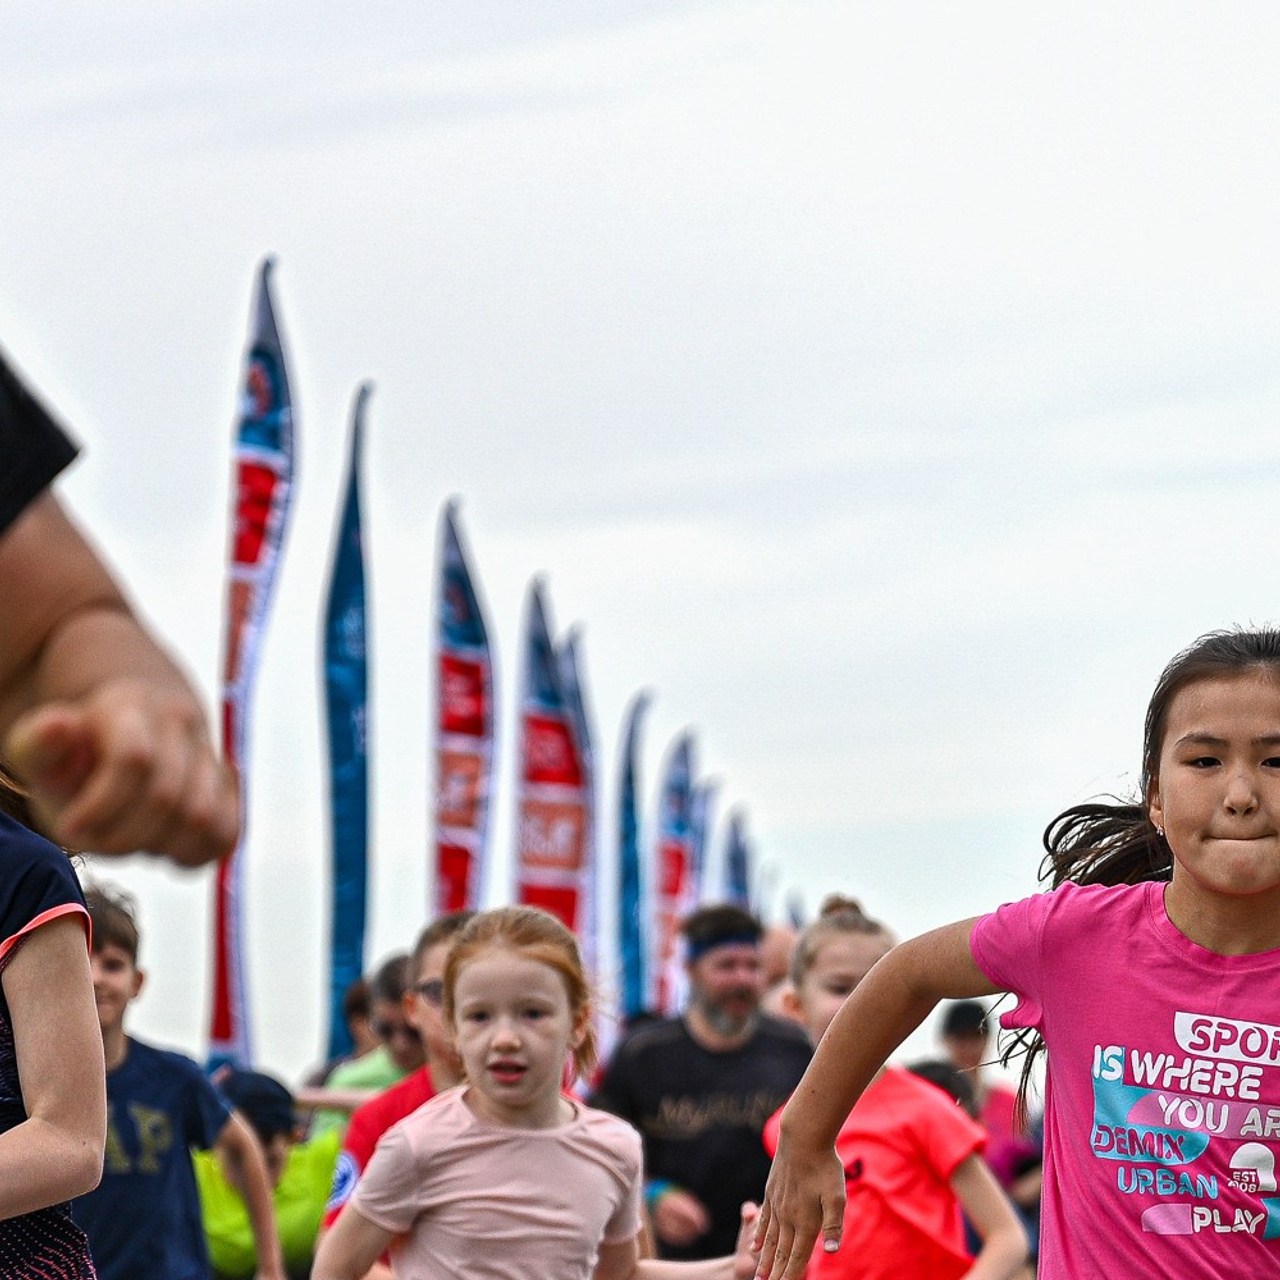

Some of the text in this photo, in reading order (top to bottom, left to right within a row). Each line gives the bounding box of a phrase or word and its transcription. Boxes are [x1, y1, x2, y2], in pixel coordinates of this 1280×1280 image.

[1093, 1044, 1264, 1101] IS WHERE
[1158, 1094, 1229, 1134] YOU
[1093, 1125, 1185, 1162] DEMIX
[1116, 1166, 1219, 1200] URBAN
[1232, 1171, 1257, 1183] EST
[1192, 1206, 1266, 1234] PLAY
